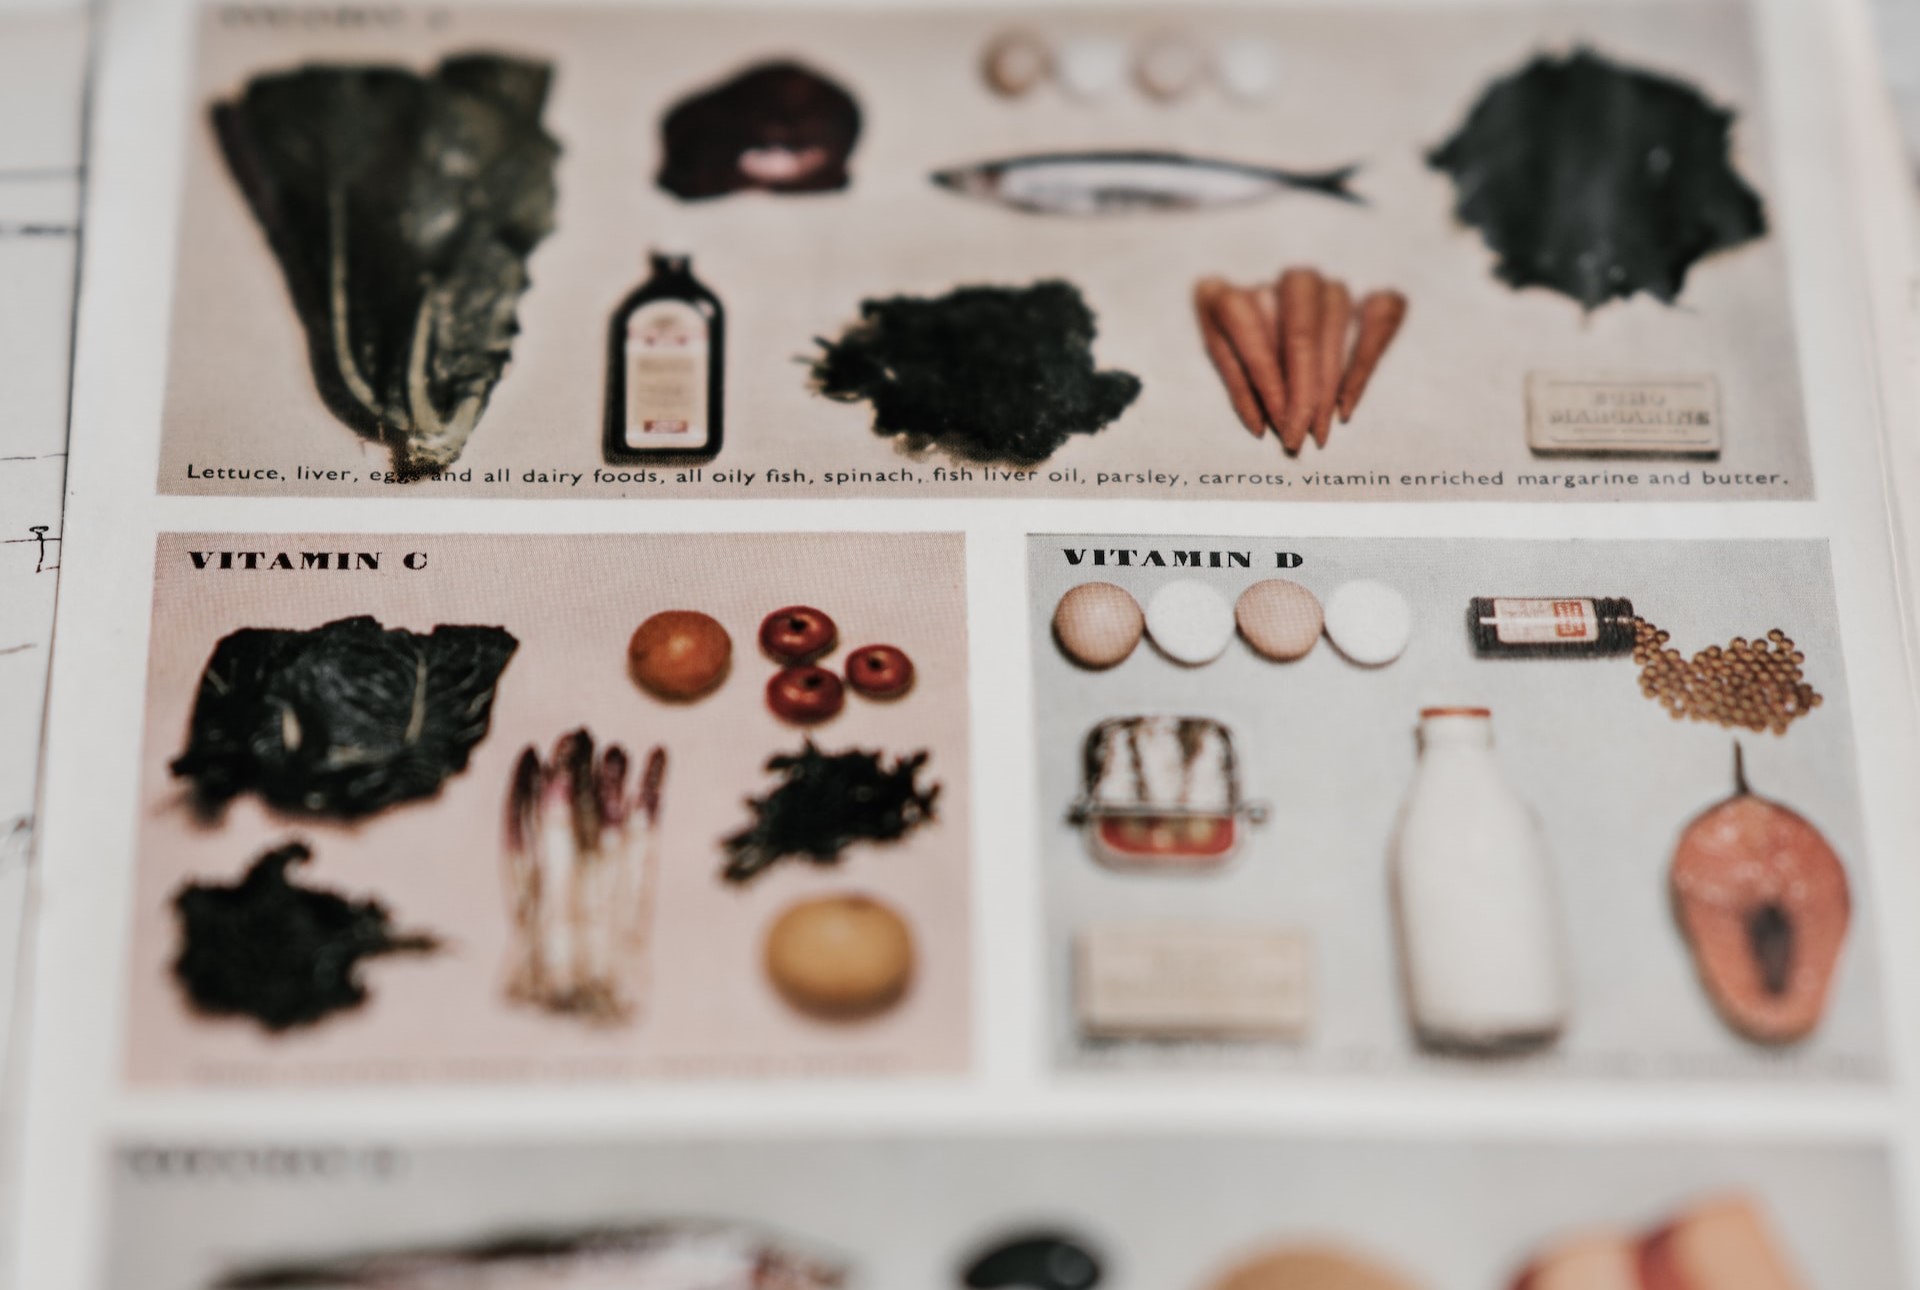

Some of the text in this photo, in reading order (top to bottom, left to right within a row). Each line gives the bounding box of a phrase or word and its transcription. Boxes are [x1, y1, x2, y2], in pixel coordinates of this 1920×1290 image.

[187, 464, 285, 482] Lettuce,
[298, 466, 358, 483] liver,
[431, 467, 472, 483] and
[484, 468, 509, 483] all
[523, 469, 583, 486] dairy
[594, 468, 664, 484] foods,
[676, 468, 702, 483] all
[712, 468, 755, 486] oily
[766, 468, 814, 485] fish,
[824, 468, 922, 485] spinach,
[933, 468, 973, 482] fish
[984, 467, 1037, 482] liver
[1049, 468, 1085, 484] oil,
[1097, 468, 1188, 487] parsley,
[1199, 472, 1292, 486] carrots,
[1302, 470, 1390, 486] vitamin
[1400, 470, 1503, 486] enriched
[1518, 470, 1638, 488] margarine
[1650, 471, 1690, 486] and
[1703, 470, 1789, 486] butter.
[187, 551, 428, 571] VITAMIN C
[1063, 548, 1304, 569] VITAMIN D
